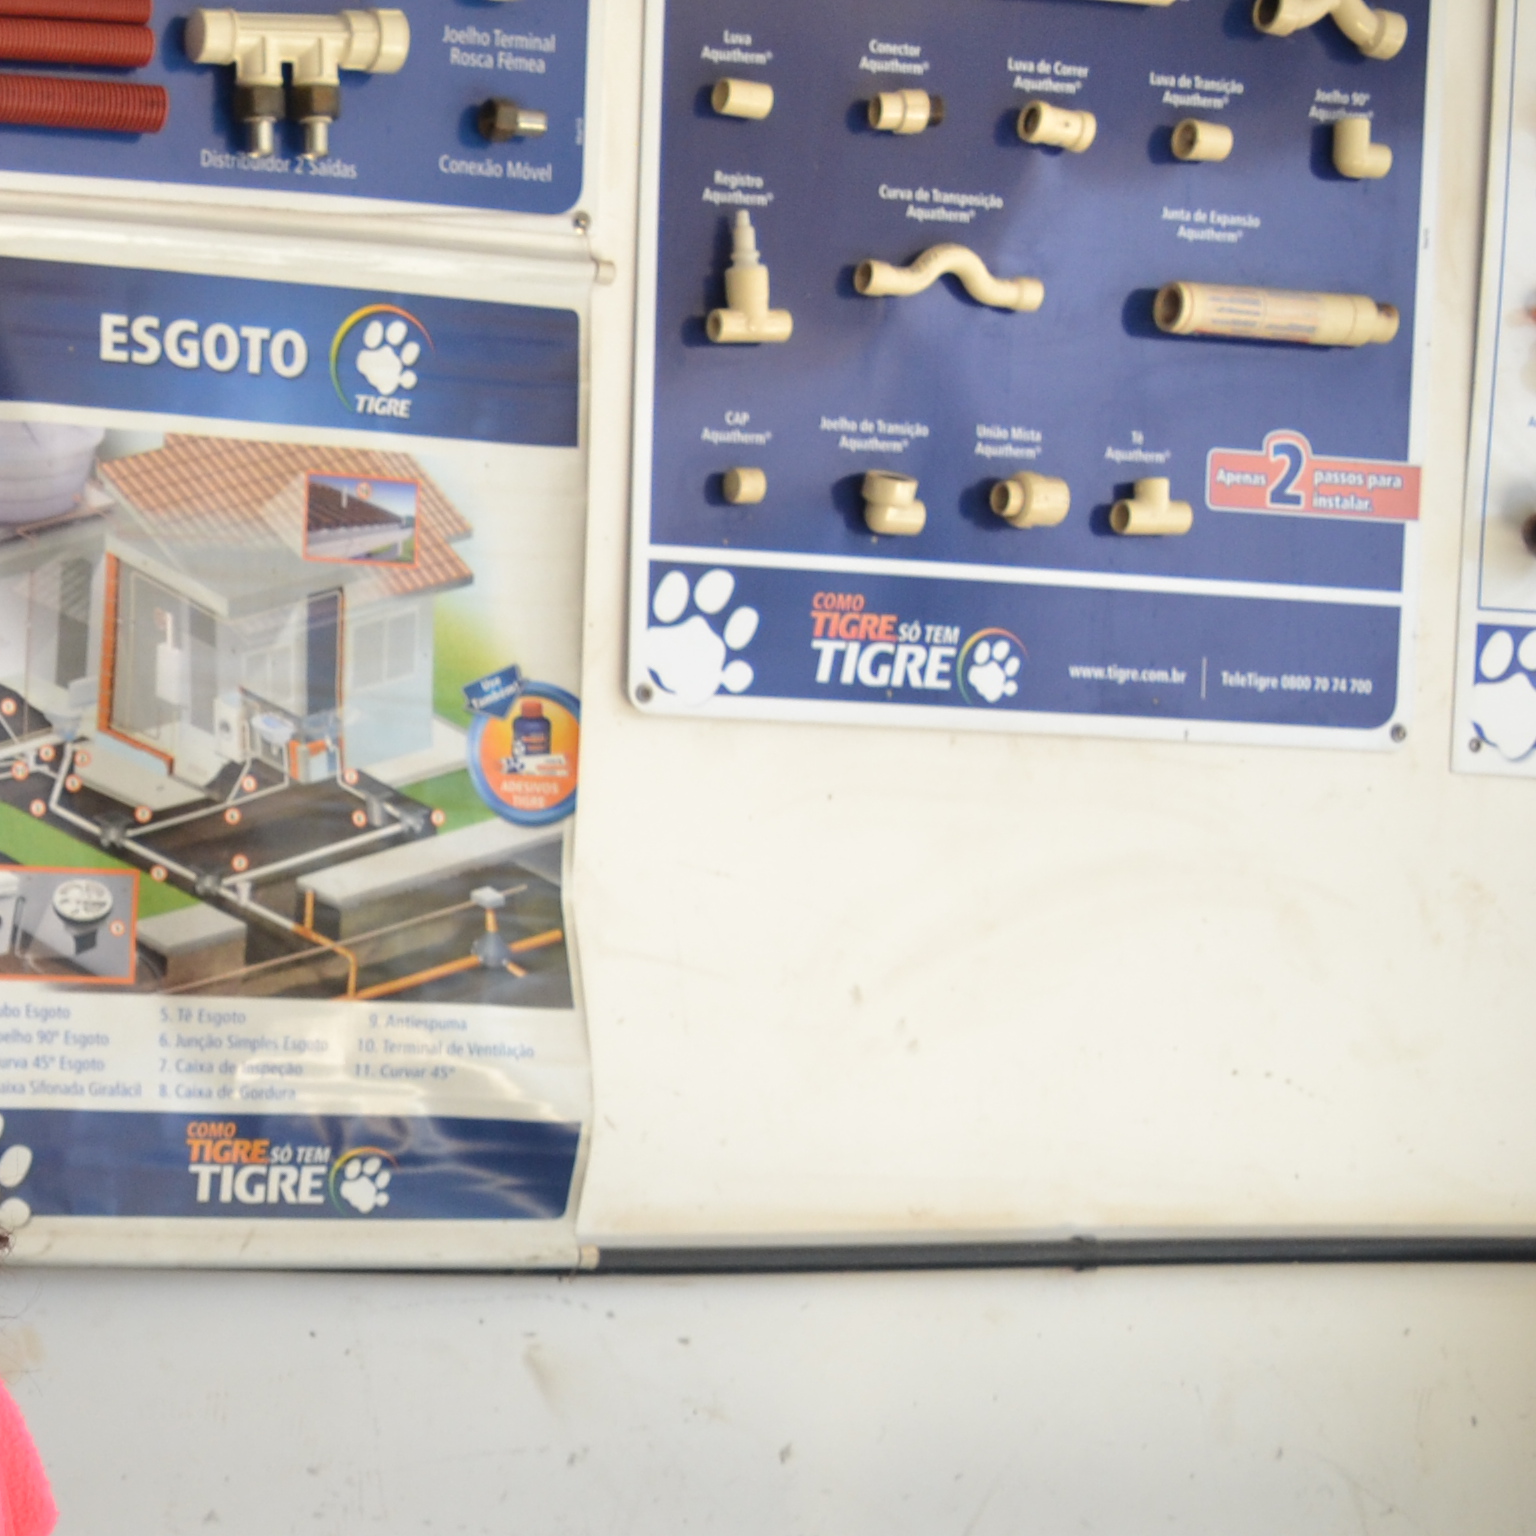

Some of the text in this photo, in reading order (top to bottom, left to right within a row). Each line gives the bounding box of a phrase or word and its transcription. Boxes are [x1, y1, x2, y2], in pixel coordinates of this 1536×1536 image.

[442, 24, 556, 53] Joelho Terminal
[450, 46, 493, 70] Rosca
[99, 312, 309, 379] ESGOTO
[354, 394, 412, 419] TIGRE
[724, 410, 750, 426] CAP
[1216, 440, 1403, 507] Apenas 2 passos para
[812, 591, 866, 611] COMO
[898, 619, 922, 643] SÓ
[924, 623, 960, 645] TEM
[811, 639, 957, 690] TIGRE
[1069, 664, 1187, 685] www.tigre.com.br
[1221, 670, 1278, 693] TeleTigre
[1281, 673, 1311, 692] 0800
[25, 1003, 70, 1022] Esgoto
[197, 1008, 246, 1028] Esgoto
[64, 1030, 109, 1049] Esgoto
[59, 1055, 105, 1075] Esgoto
[187, 1121, 236, 1137] COMO
[270, 1142, 292, 1163] SÓ
[296, 1146, 331, 1163] TEM
[189, 1164, 328, 1204] TIGRE
